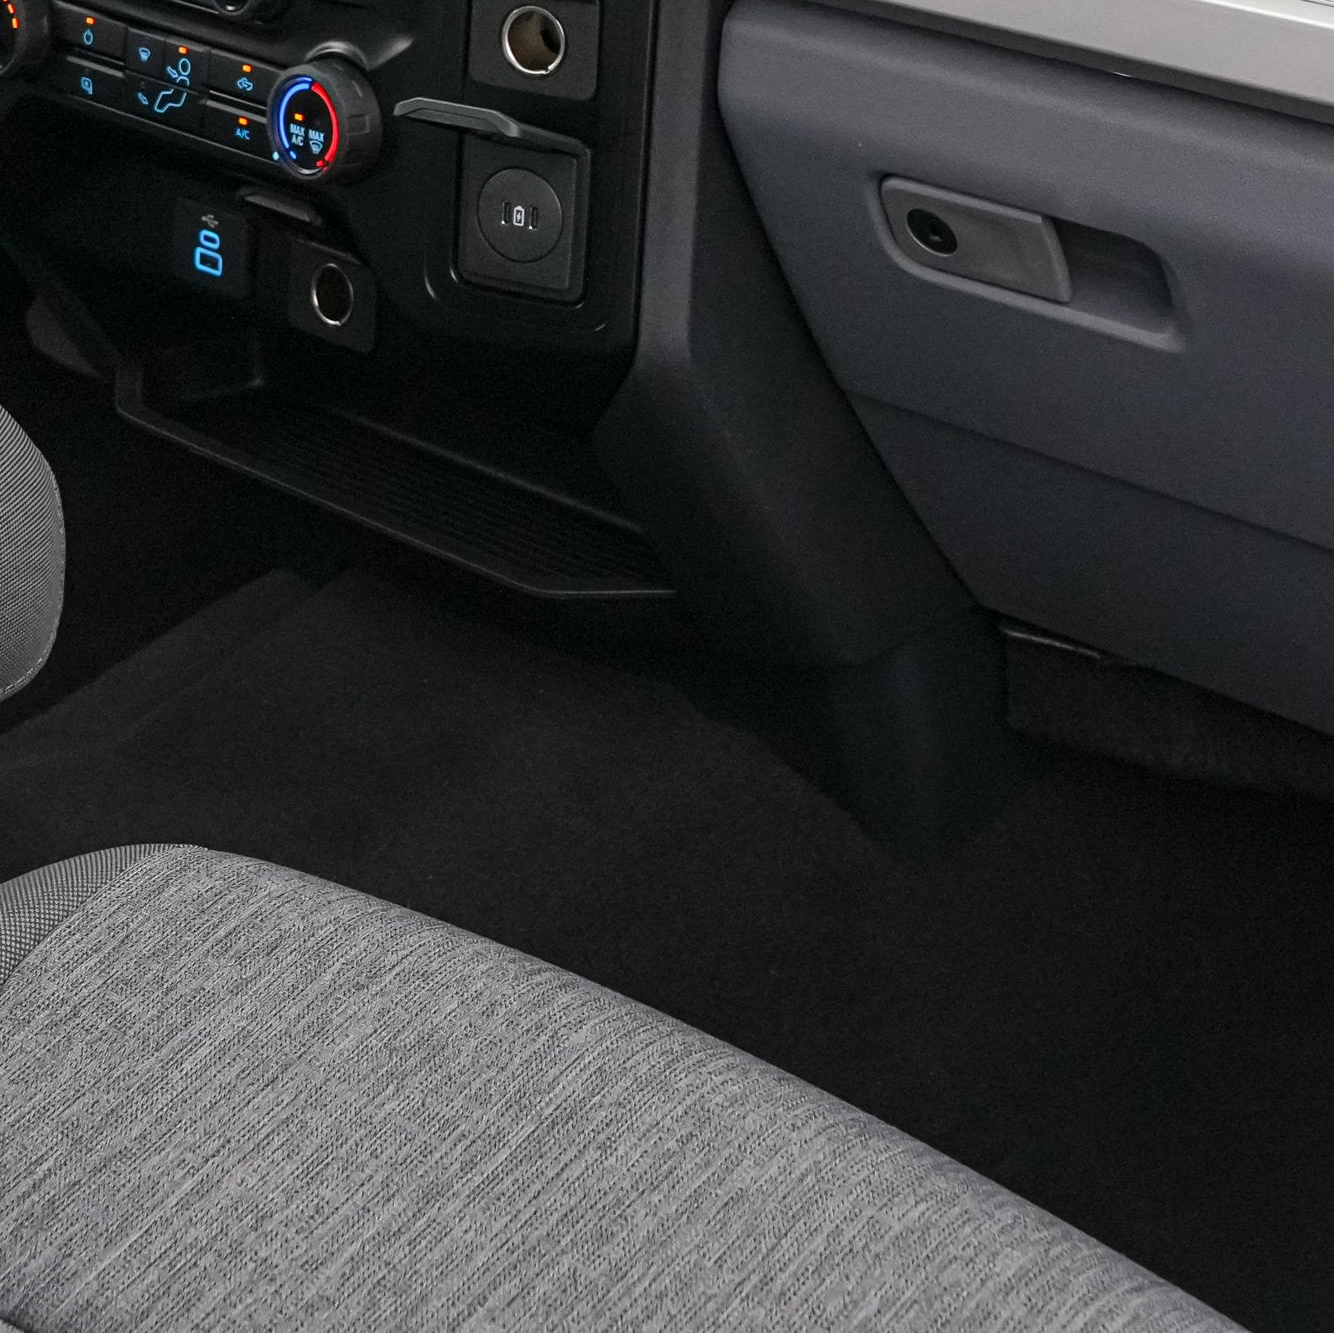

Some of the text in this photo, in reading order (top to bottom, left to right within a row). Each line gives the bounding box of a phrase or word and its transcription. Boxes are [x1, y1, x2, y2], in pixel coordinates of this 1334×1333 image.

[235, 128, 250, 140] A/C
[290, 123, 305, 137] MAX
[308, 129, 325, 142] MAX
[291, 135, 304, 146] A/C
